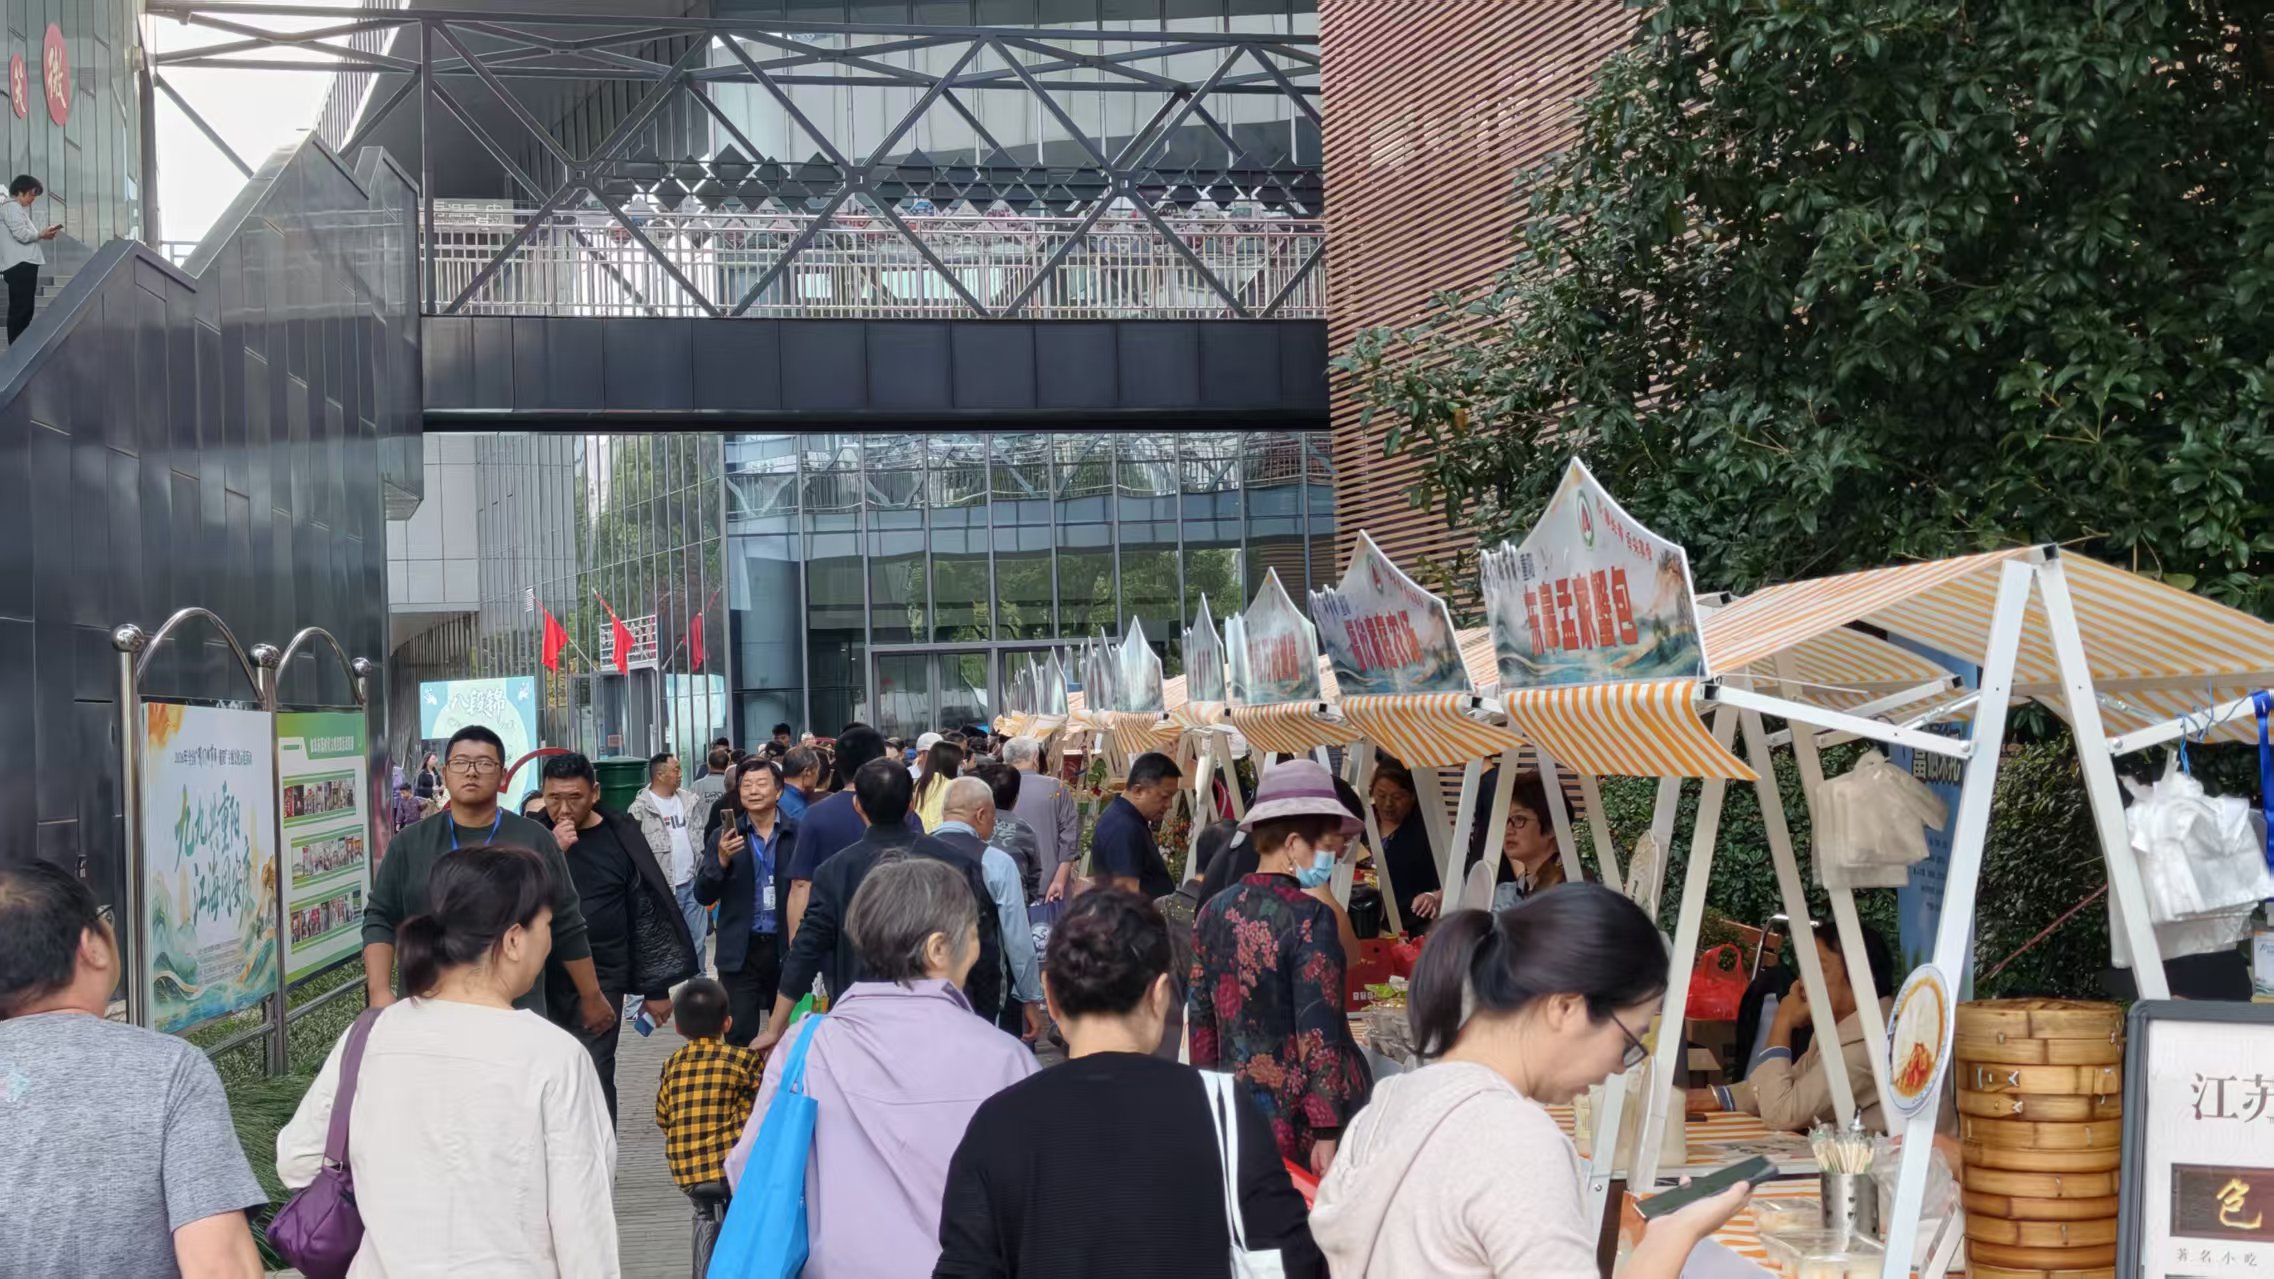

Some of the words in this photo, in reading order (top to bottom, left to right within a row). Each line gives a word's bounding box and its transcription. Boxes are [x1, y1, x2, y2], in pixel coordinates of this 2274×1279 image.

[450, 687, 505, 720] 八段锦
[2191, 1073, 2274, 1123] 江苏
